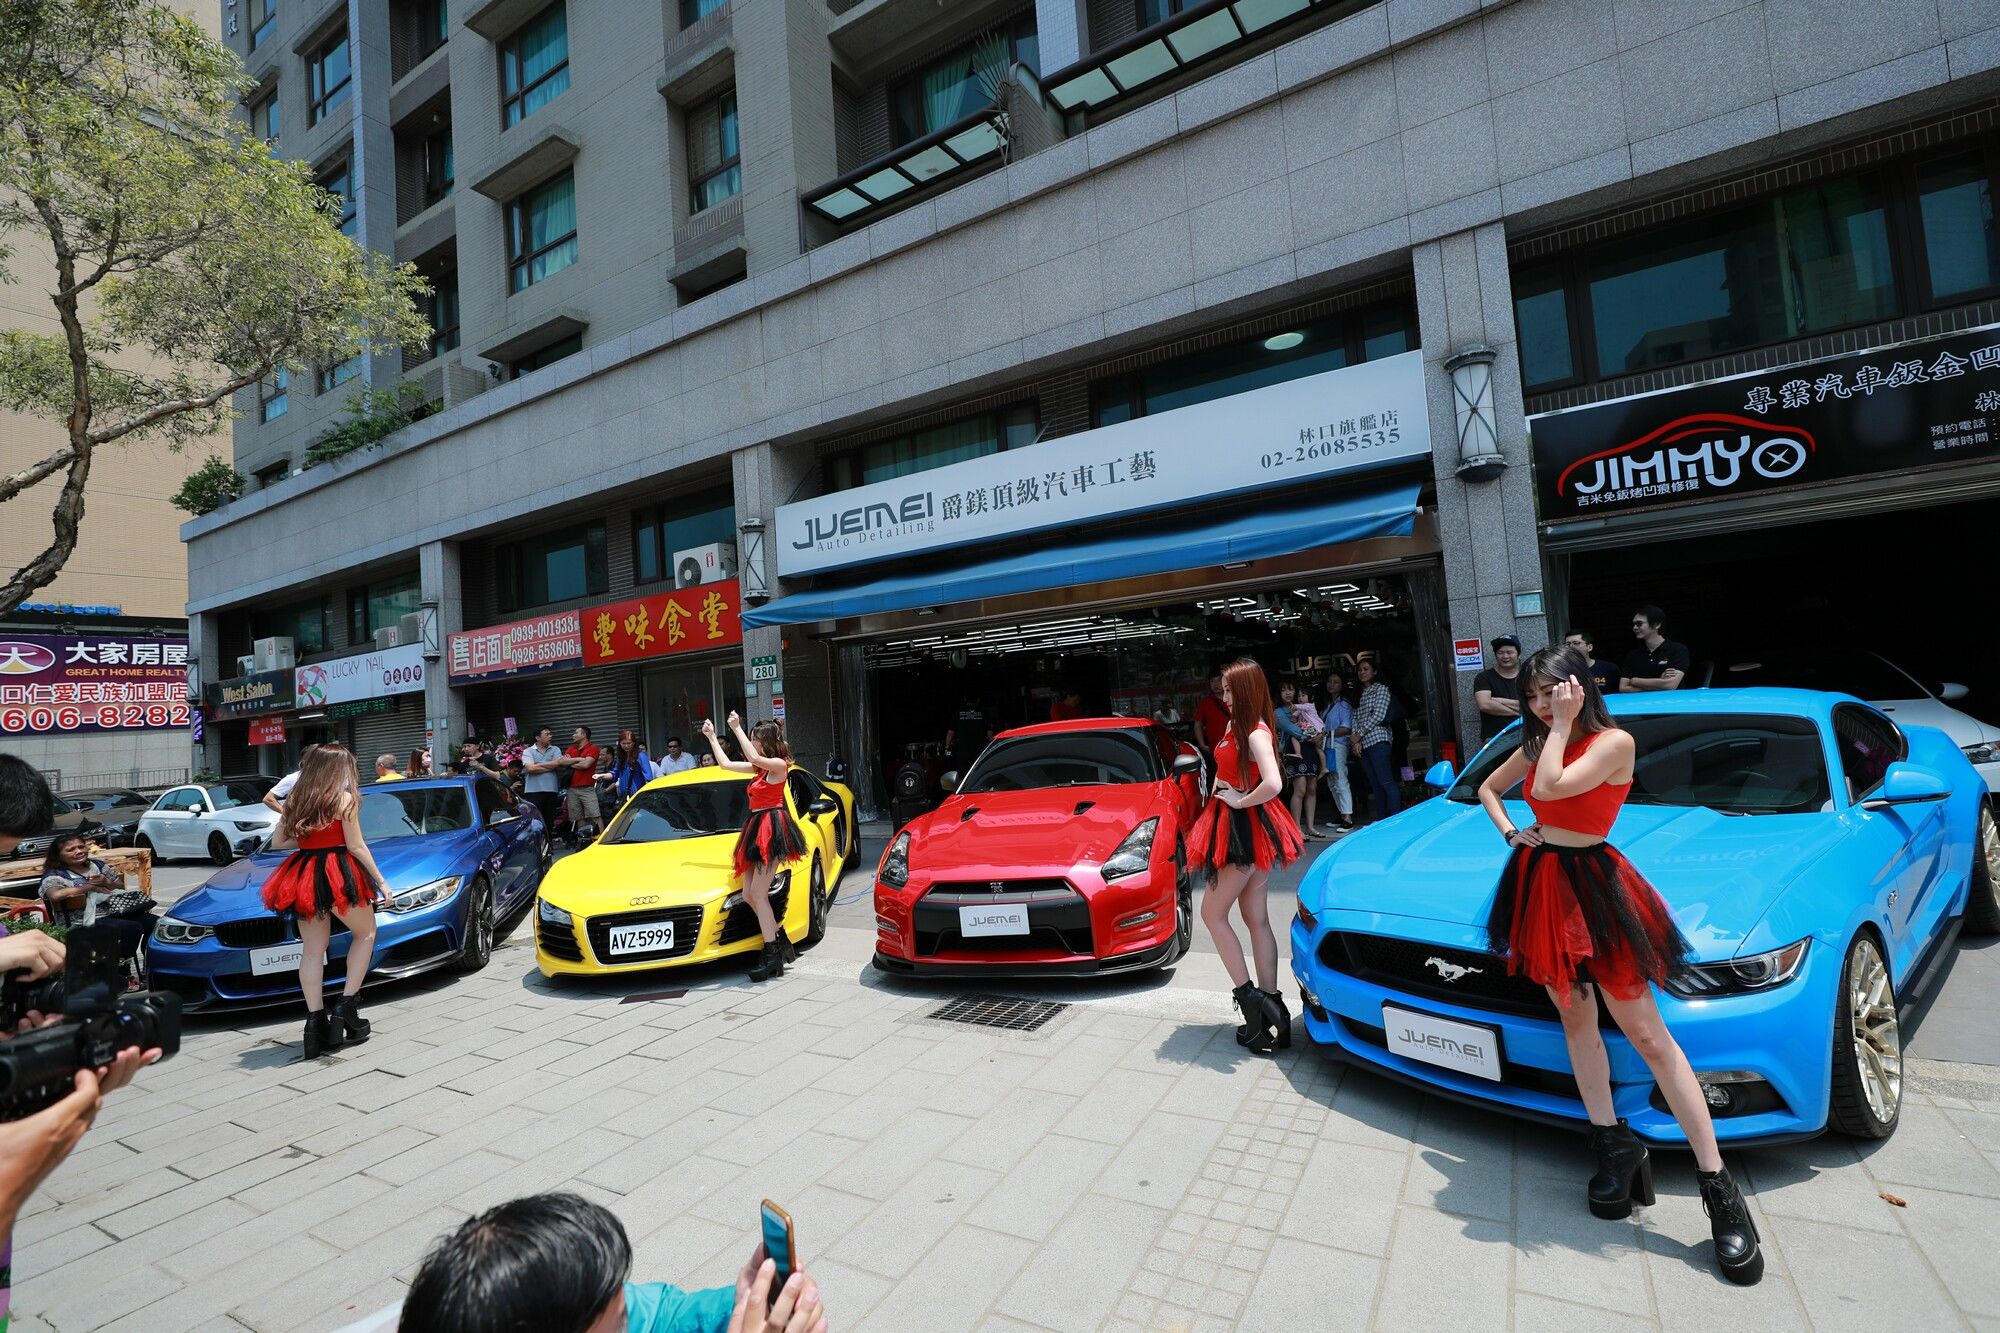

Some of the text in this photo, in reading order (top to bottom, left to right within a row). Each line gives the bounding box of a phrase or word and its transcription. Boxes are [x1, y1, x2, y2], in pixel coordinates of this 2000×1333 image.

[1299, 410, 1398, 445] 林口旗艦店
[1261, 428, 1400, 468] 02-26085535
[942, 450, 1156, 521] 爵鎂頂級汽車工藝
[792, 491, 933, 550] JUEMEI
[817, 520, 935, 552] Auto Detailing
[511, 617, 574, 643] 0939-001933
[65, 641, 188, 666] 大家房屋
[452, 633, 501, 672] 售店面
[511, 639, 575, 664] 0926-553606
[65, 668, 188, 677] GREAT HOME REALTY
[332, 655, 385, 679] LUCKY NAIL
[755, 666, 774, 679] 280
[223, 682, 273, 702] West Salon
[1, 704, 190, 731] 606-8282
[968, 915, 1021, 927] JUEMEI
[612, 928, 672, 950] AVZ-5999
[261, 953, 303, 966] JUEM
[1398, 1028, 1483, 1059] JUEMEI
